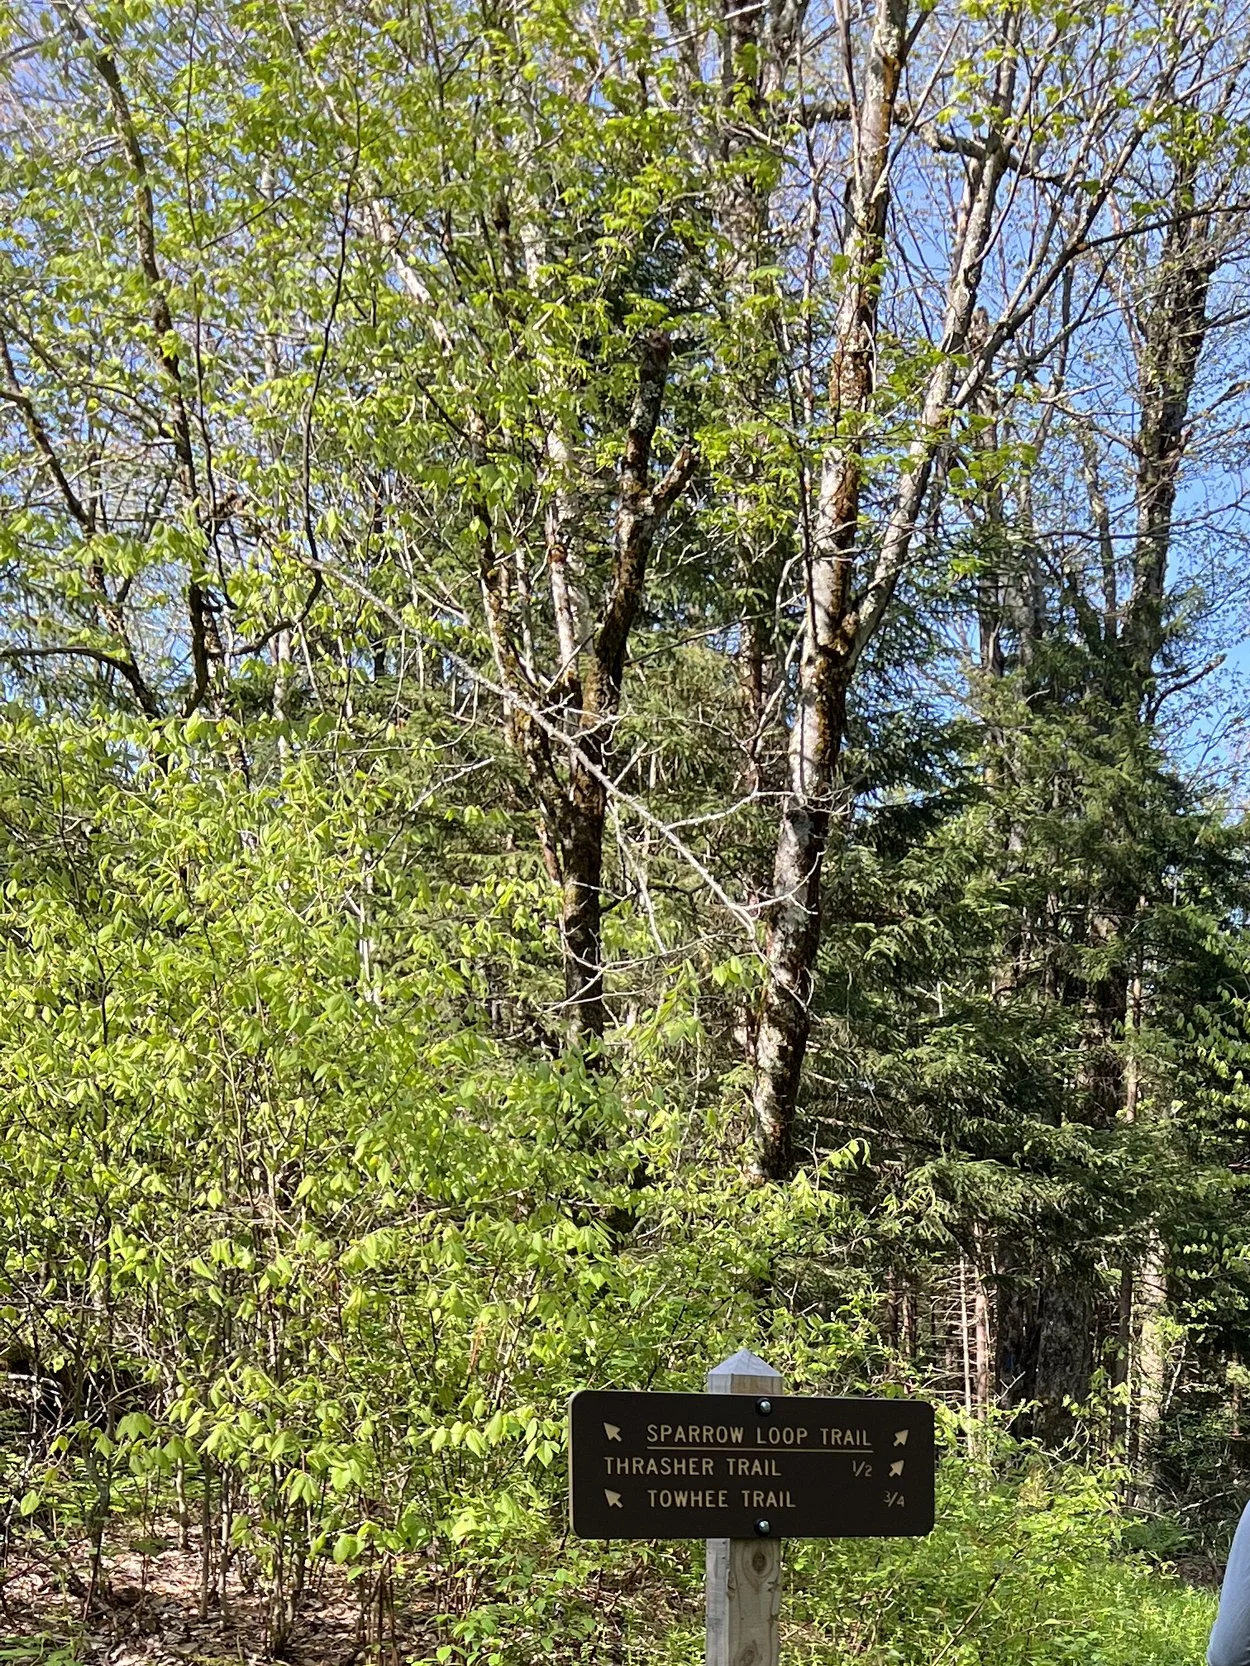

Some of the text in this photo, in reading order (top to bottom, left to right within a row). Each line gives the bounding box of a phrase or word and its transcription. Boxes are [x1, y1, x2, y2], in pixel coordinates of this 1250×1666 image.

[646, 1424, 872, 1446] SPARROW LOOP TRAIL
[603, 1456, 873, 1477] THRASHER TRAIL 1/2
[647, 1490, 905, 1508] TOWHEE TRAIL 3/4
